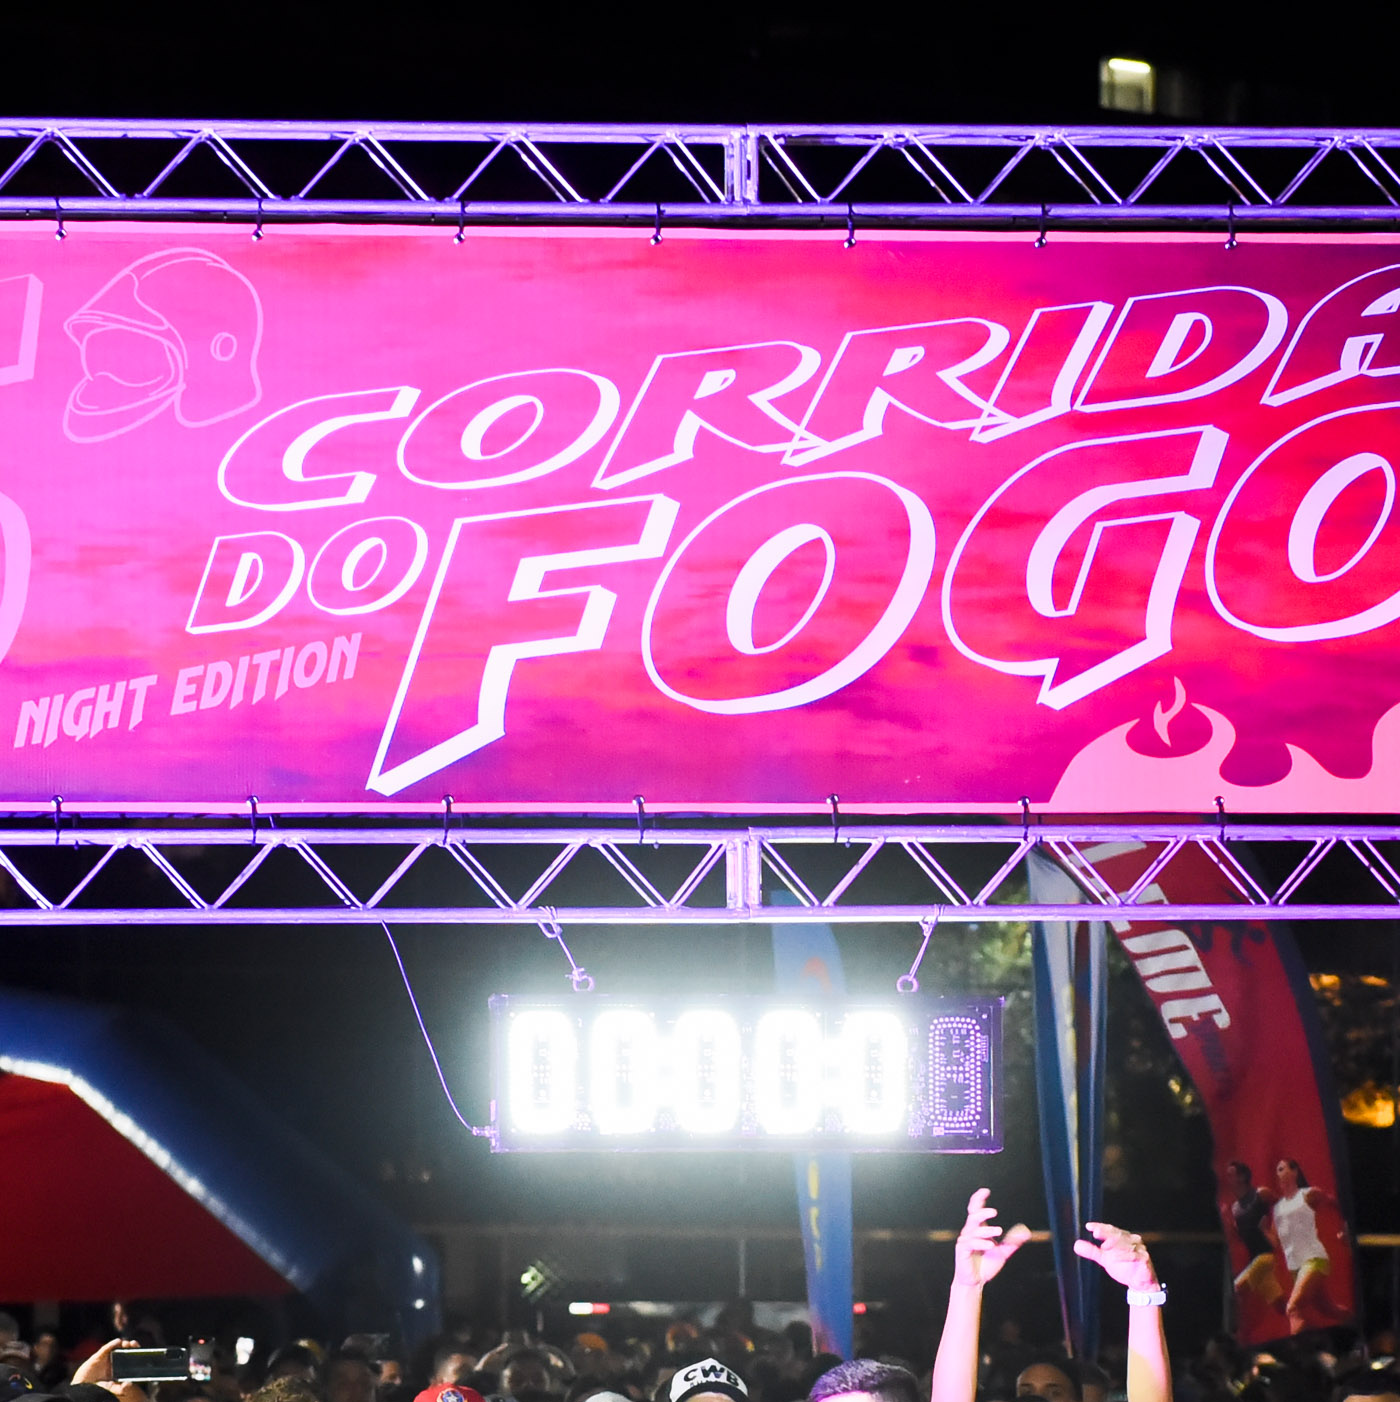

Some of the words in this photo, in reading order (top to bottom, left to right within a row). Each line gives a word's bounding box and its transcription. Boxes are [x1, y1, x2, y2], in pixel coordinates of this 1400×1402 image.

[185, 516, 429, 634] DO
[14, 674, 158, 748] NIGHT
[170, 632, 362, 716] EDITION
[683, 1365, 740, 1387] CWB
